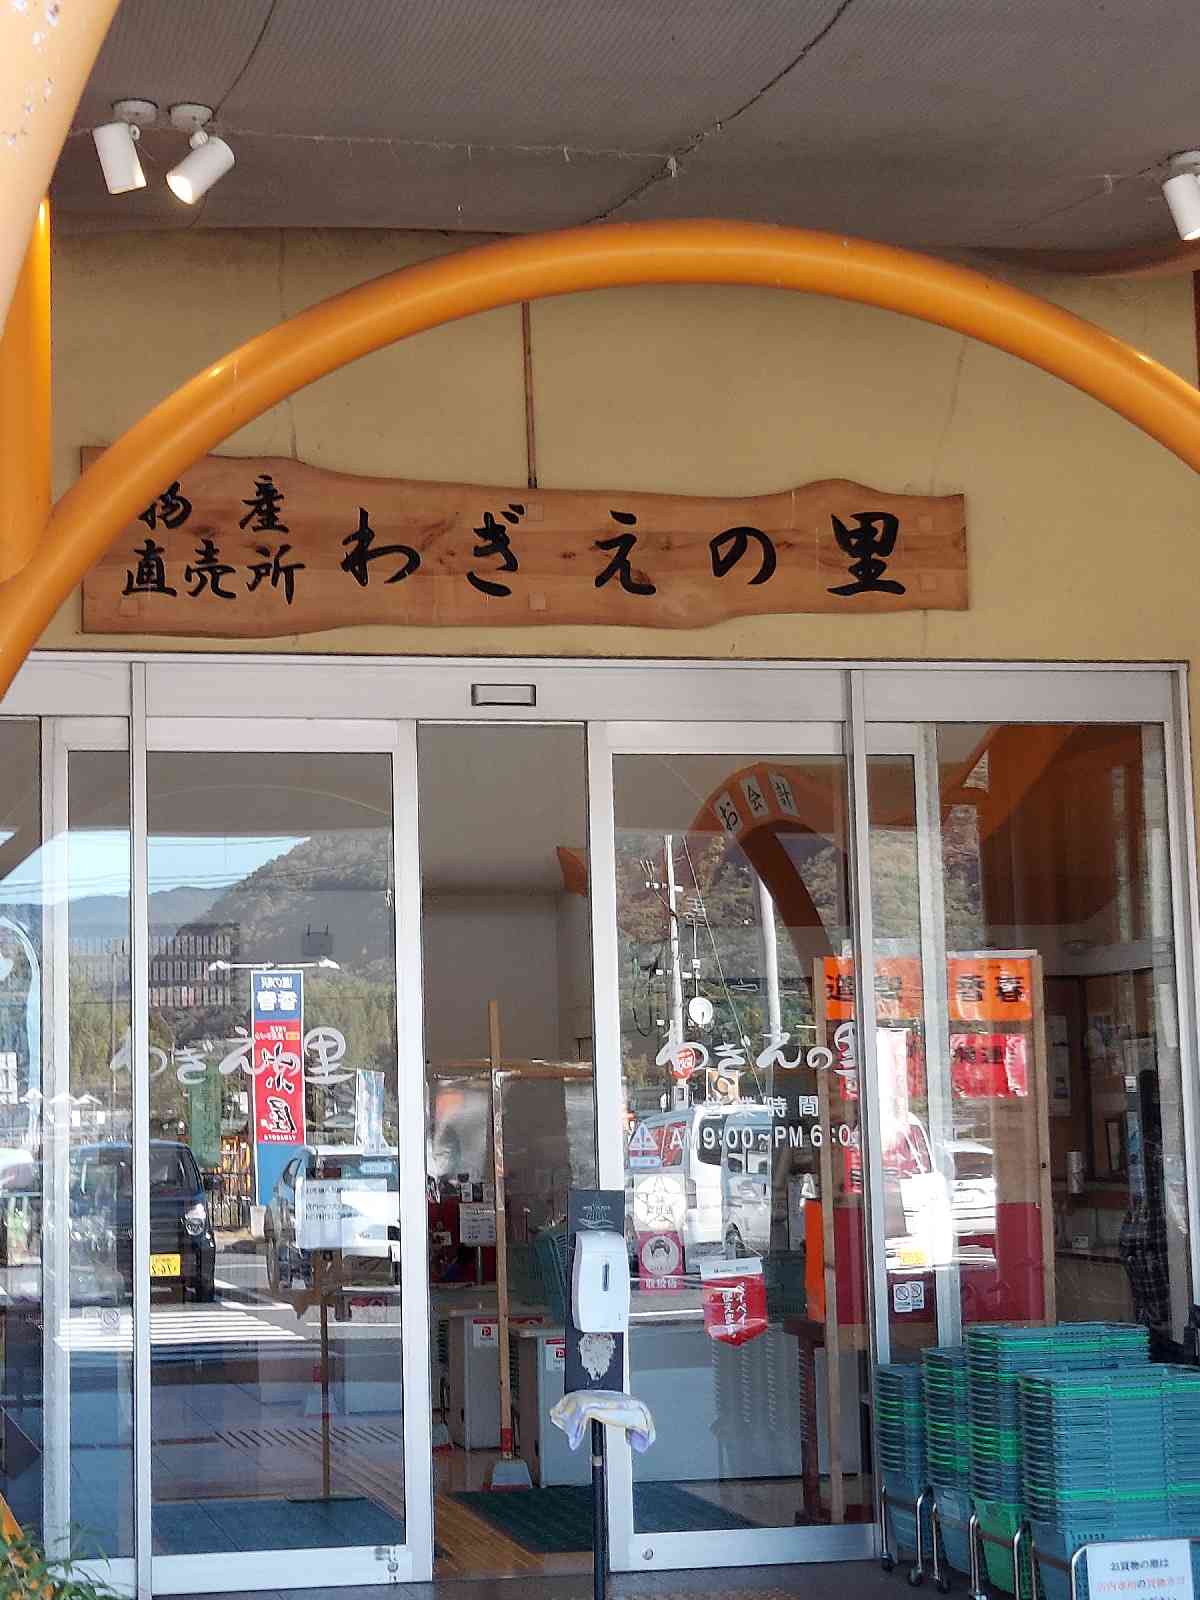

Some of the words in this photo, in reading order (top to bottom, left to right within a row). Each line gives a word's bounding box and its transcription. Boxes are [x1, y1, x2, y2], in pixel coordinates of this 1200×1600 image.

[122, 538, 306, 605] 直売所
[340, 503, 906, 598] わぎえの里
